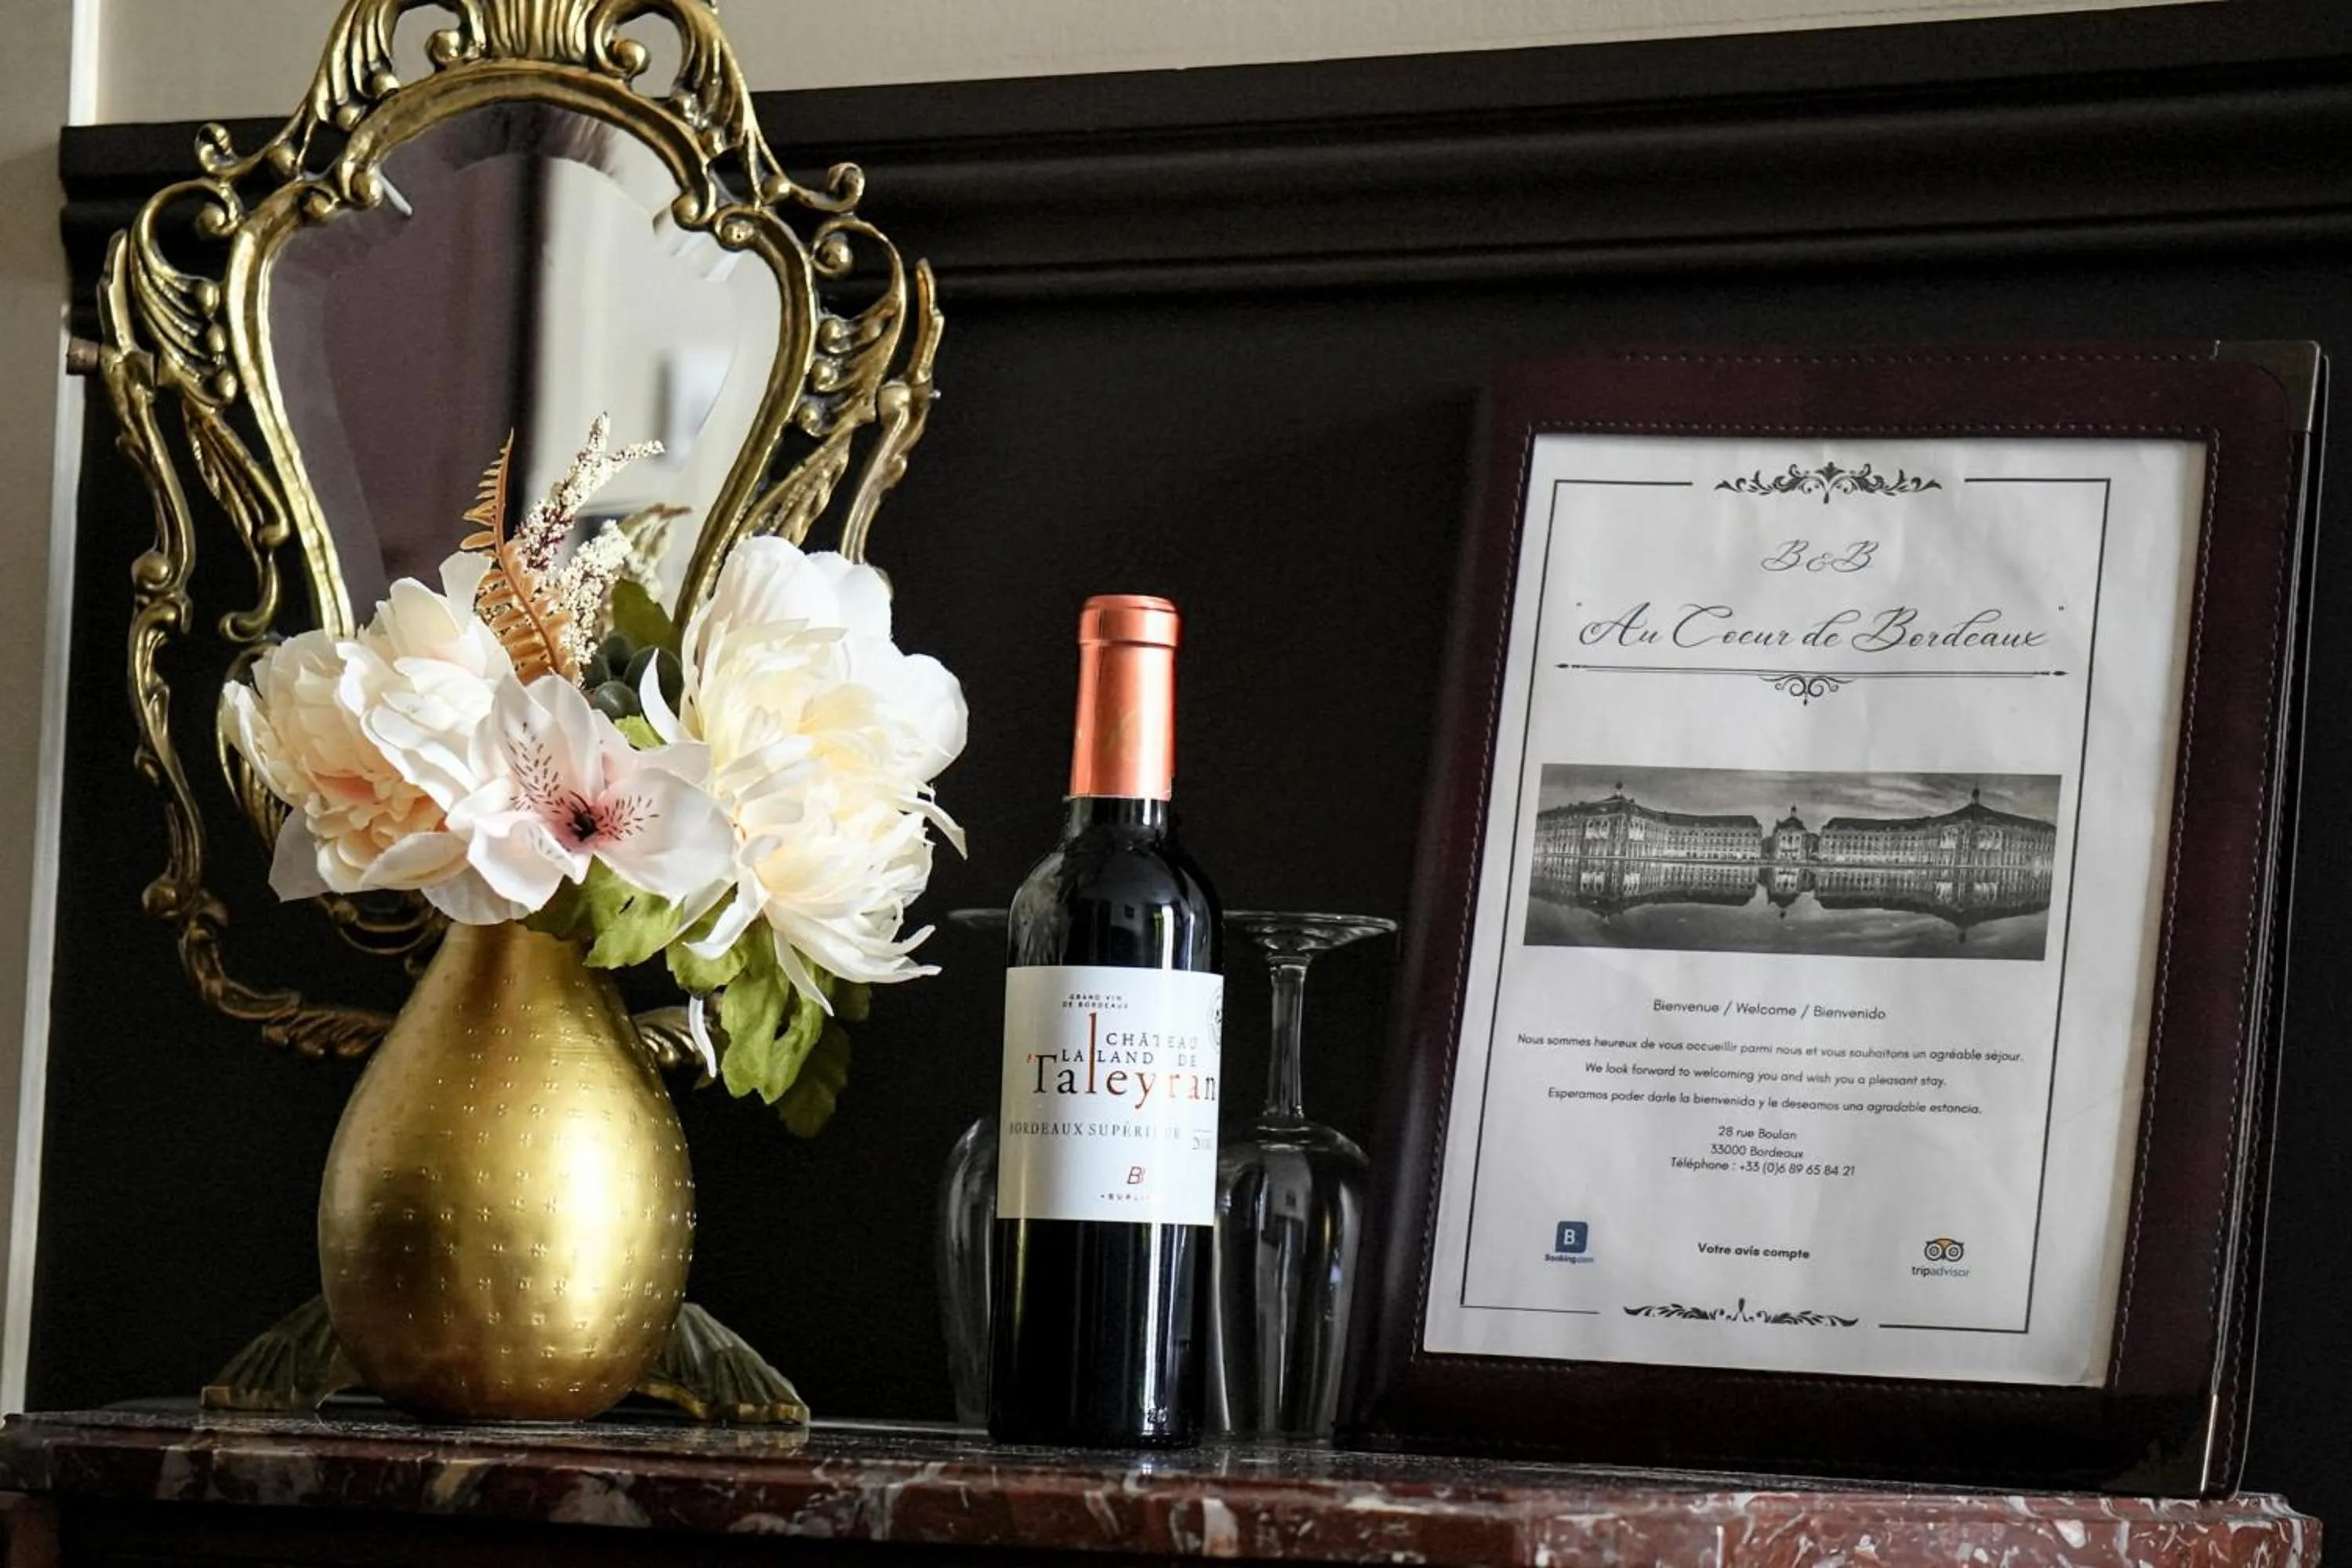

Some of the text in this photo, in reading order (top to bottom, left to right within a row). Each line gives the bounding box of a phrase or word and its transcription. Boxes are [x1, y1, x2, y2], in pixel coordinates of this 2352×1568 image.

[1671, 602, 1795, 648] Coeur
[1801, 608, 1863, 648] de
[1653, 998, 1721, 1014] Bienvenue
[1735, 1002, 1797, 1017] Welcome
[1813, 1004, 1886, 1020] Bienvenido
[1061, 1049, 1083, 1063] LA
[1097, 1050, 1163, 1065] LAND
[1517, 1033, 1544, 1045] Nous
[1547, 1037, 1592, 1047] sommes
[1593, 1036, 1638, 1049] heureux
[1640, 1037, 1656, 1050] de
[1657, 1040, 1684, 1051] vous
[1686, 1040, 1738, 1052] accueillir
[1739, 1044, 1773, 1054] parmi
[1775, 1047, 1803, 1056] nous
[1805, 1047, 1818, 1056] et
[1820, 1048, 1846, 1058] vous
[1849, 1047, 1910, 1059] souhaitons
[1911, 1051, 1927, 1059] un
[1929, 1048, 1983, 1063] agréable
[1584, 1062, 1947, 1090] We look forward to welcoming you and wish you a pleasant stay.
[1547, 1086, 1983, 1115] Esperamos poder darle la bienvenida y le deseamos una agradable estancia.
[1717, 1125, 1798, 1141] 28 rue Boulan
[1709, 1142, 1805, 1160] 33000 Bordeaux
[1670, 1156, 1730, 1172] Téléphone
[1738, 1160, 1760, 1173] +33
[1762, 1161, 1786, 1176] (0)6
[1788, 1163, 1804, 1174] 89
[1806, 1163, 1821, 1176] 65
[1823, 1164, 1839, 1176] 84
[1842, 1165, 1856, 1177] 21
[1697, 1241, 1810, 1261] Votre avis compte
